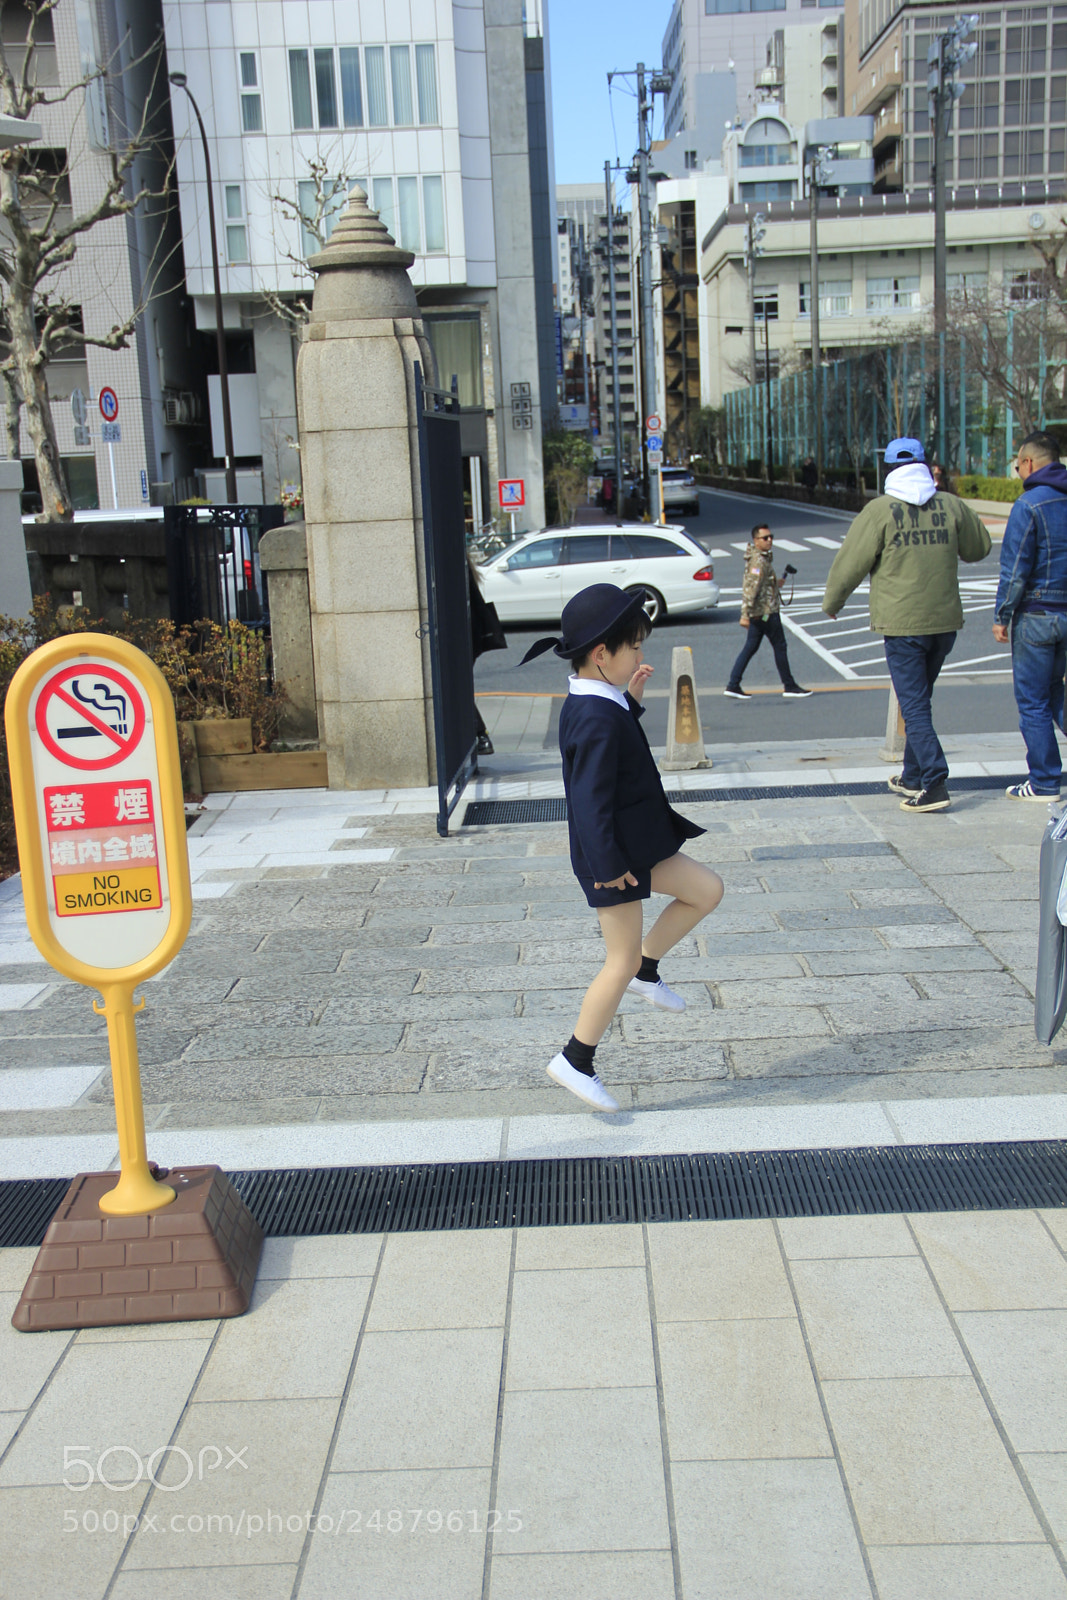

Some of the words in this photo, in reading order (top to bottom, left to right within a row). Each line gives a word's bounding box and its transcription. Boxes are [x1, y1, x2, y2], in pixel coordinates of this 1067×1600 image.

[931, 512, 947, 527] OF
[893, 529, 949, 548] SYSTEM
[49, 788, 150, 826] 禁煙
[51, 834, 156, 866] 境内全域
[93, 875, 120, 890] NO
[64, 888, 152, 908] SMOKING
